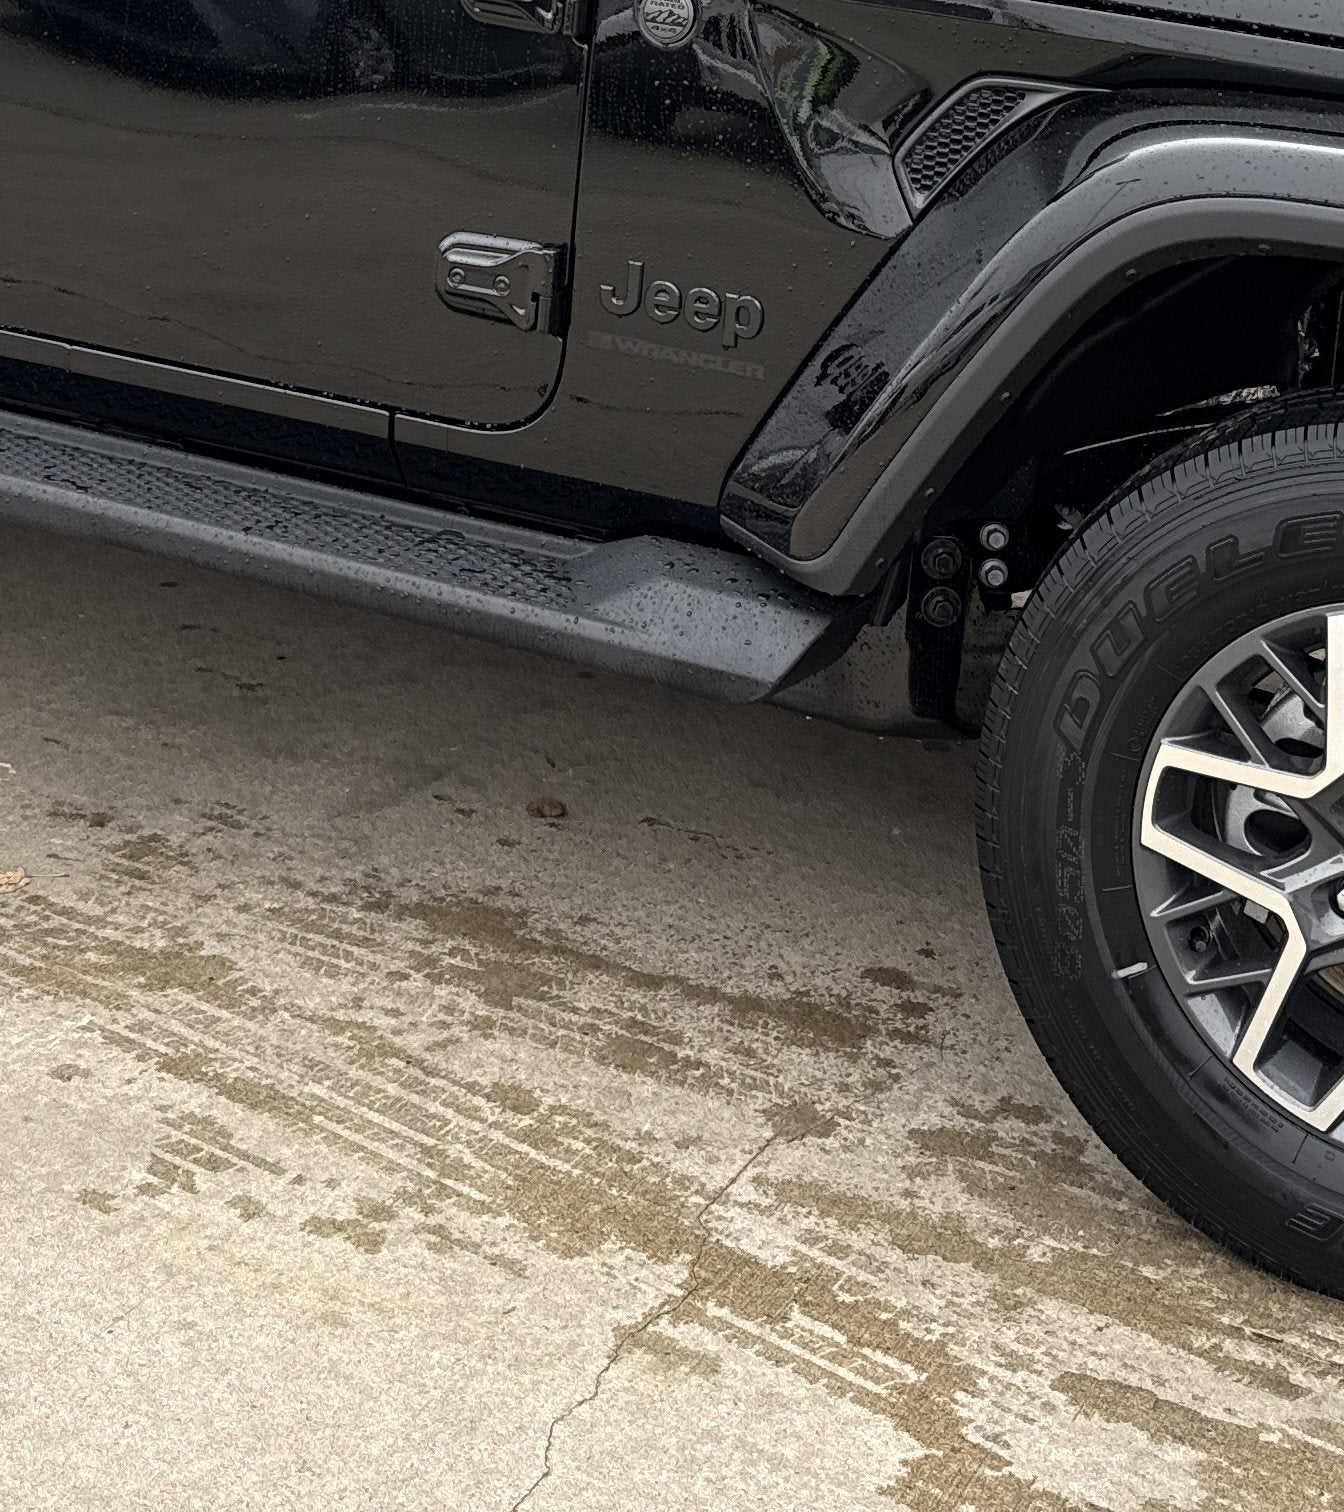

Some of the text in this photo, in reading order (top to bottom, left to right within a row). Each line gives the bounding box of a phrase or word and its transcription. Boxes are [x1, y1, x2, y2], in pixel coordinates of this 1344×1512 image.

[650, 0, 686, 10] RATED
[599, 260, 765, 350] Jeep
[616, 337, 766, 378] WRANGLER
